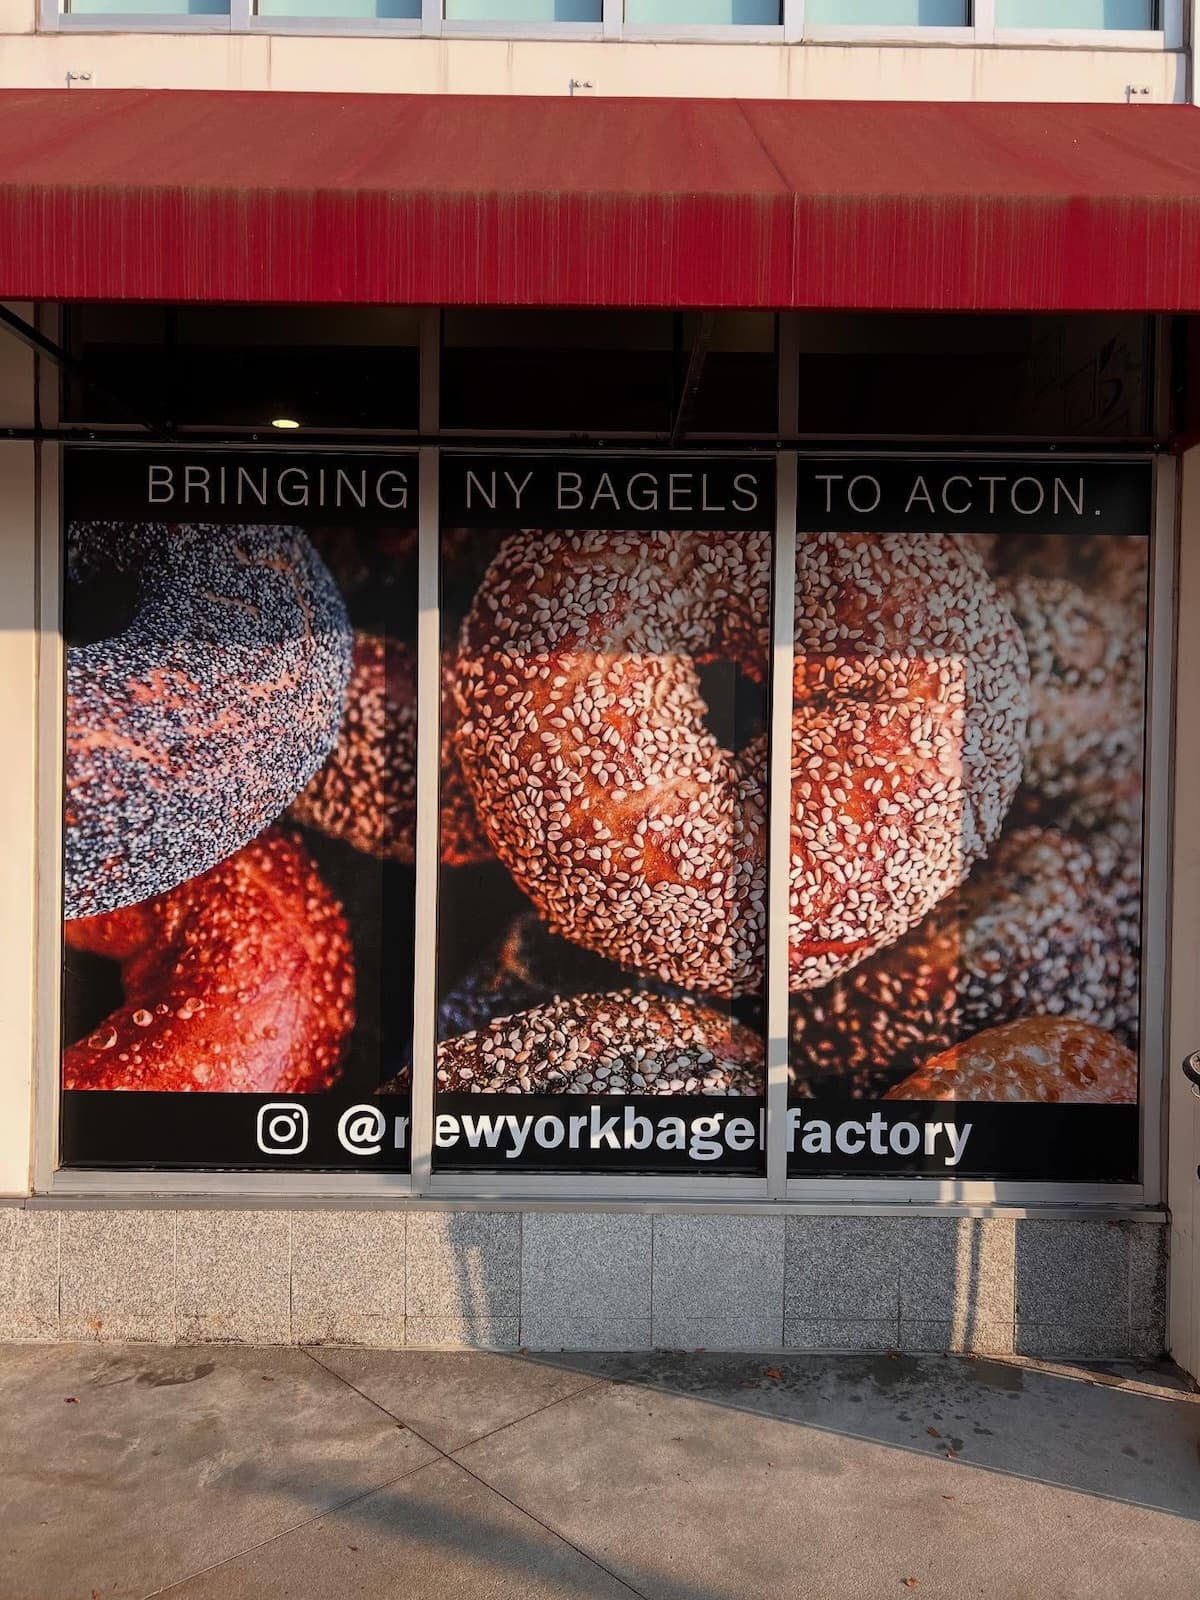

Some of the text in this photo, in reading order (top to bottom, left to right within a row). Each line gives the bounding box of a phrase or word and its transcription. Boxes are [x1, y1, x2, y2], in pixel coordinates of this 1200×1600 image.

[148, 465, 1101, 517] BRINGING NY BAGELS TO ACTON.
